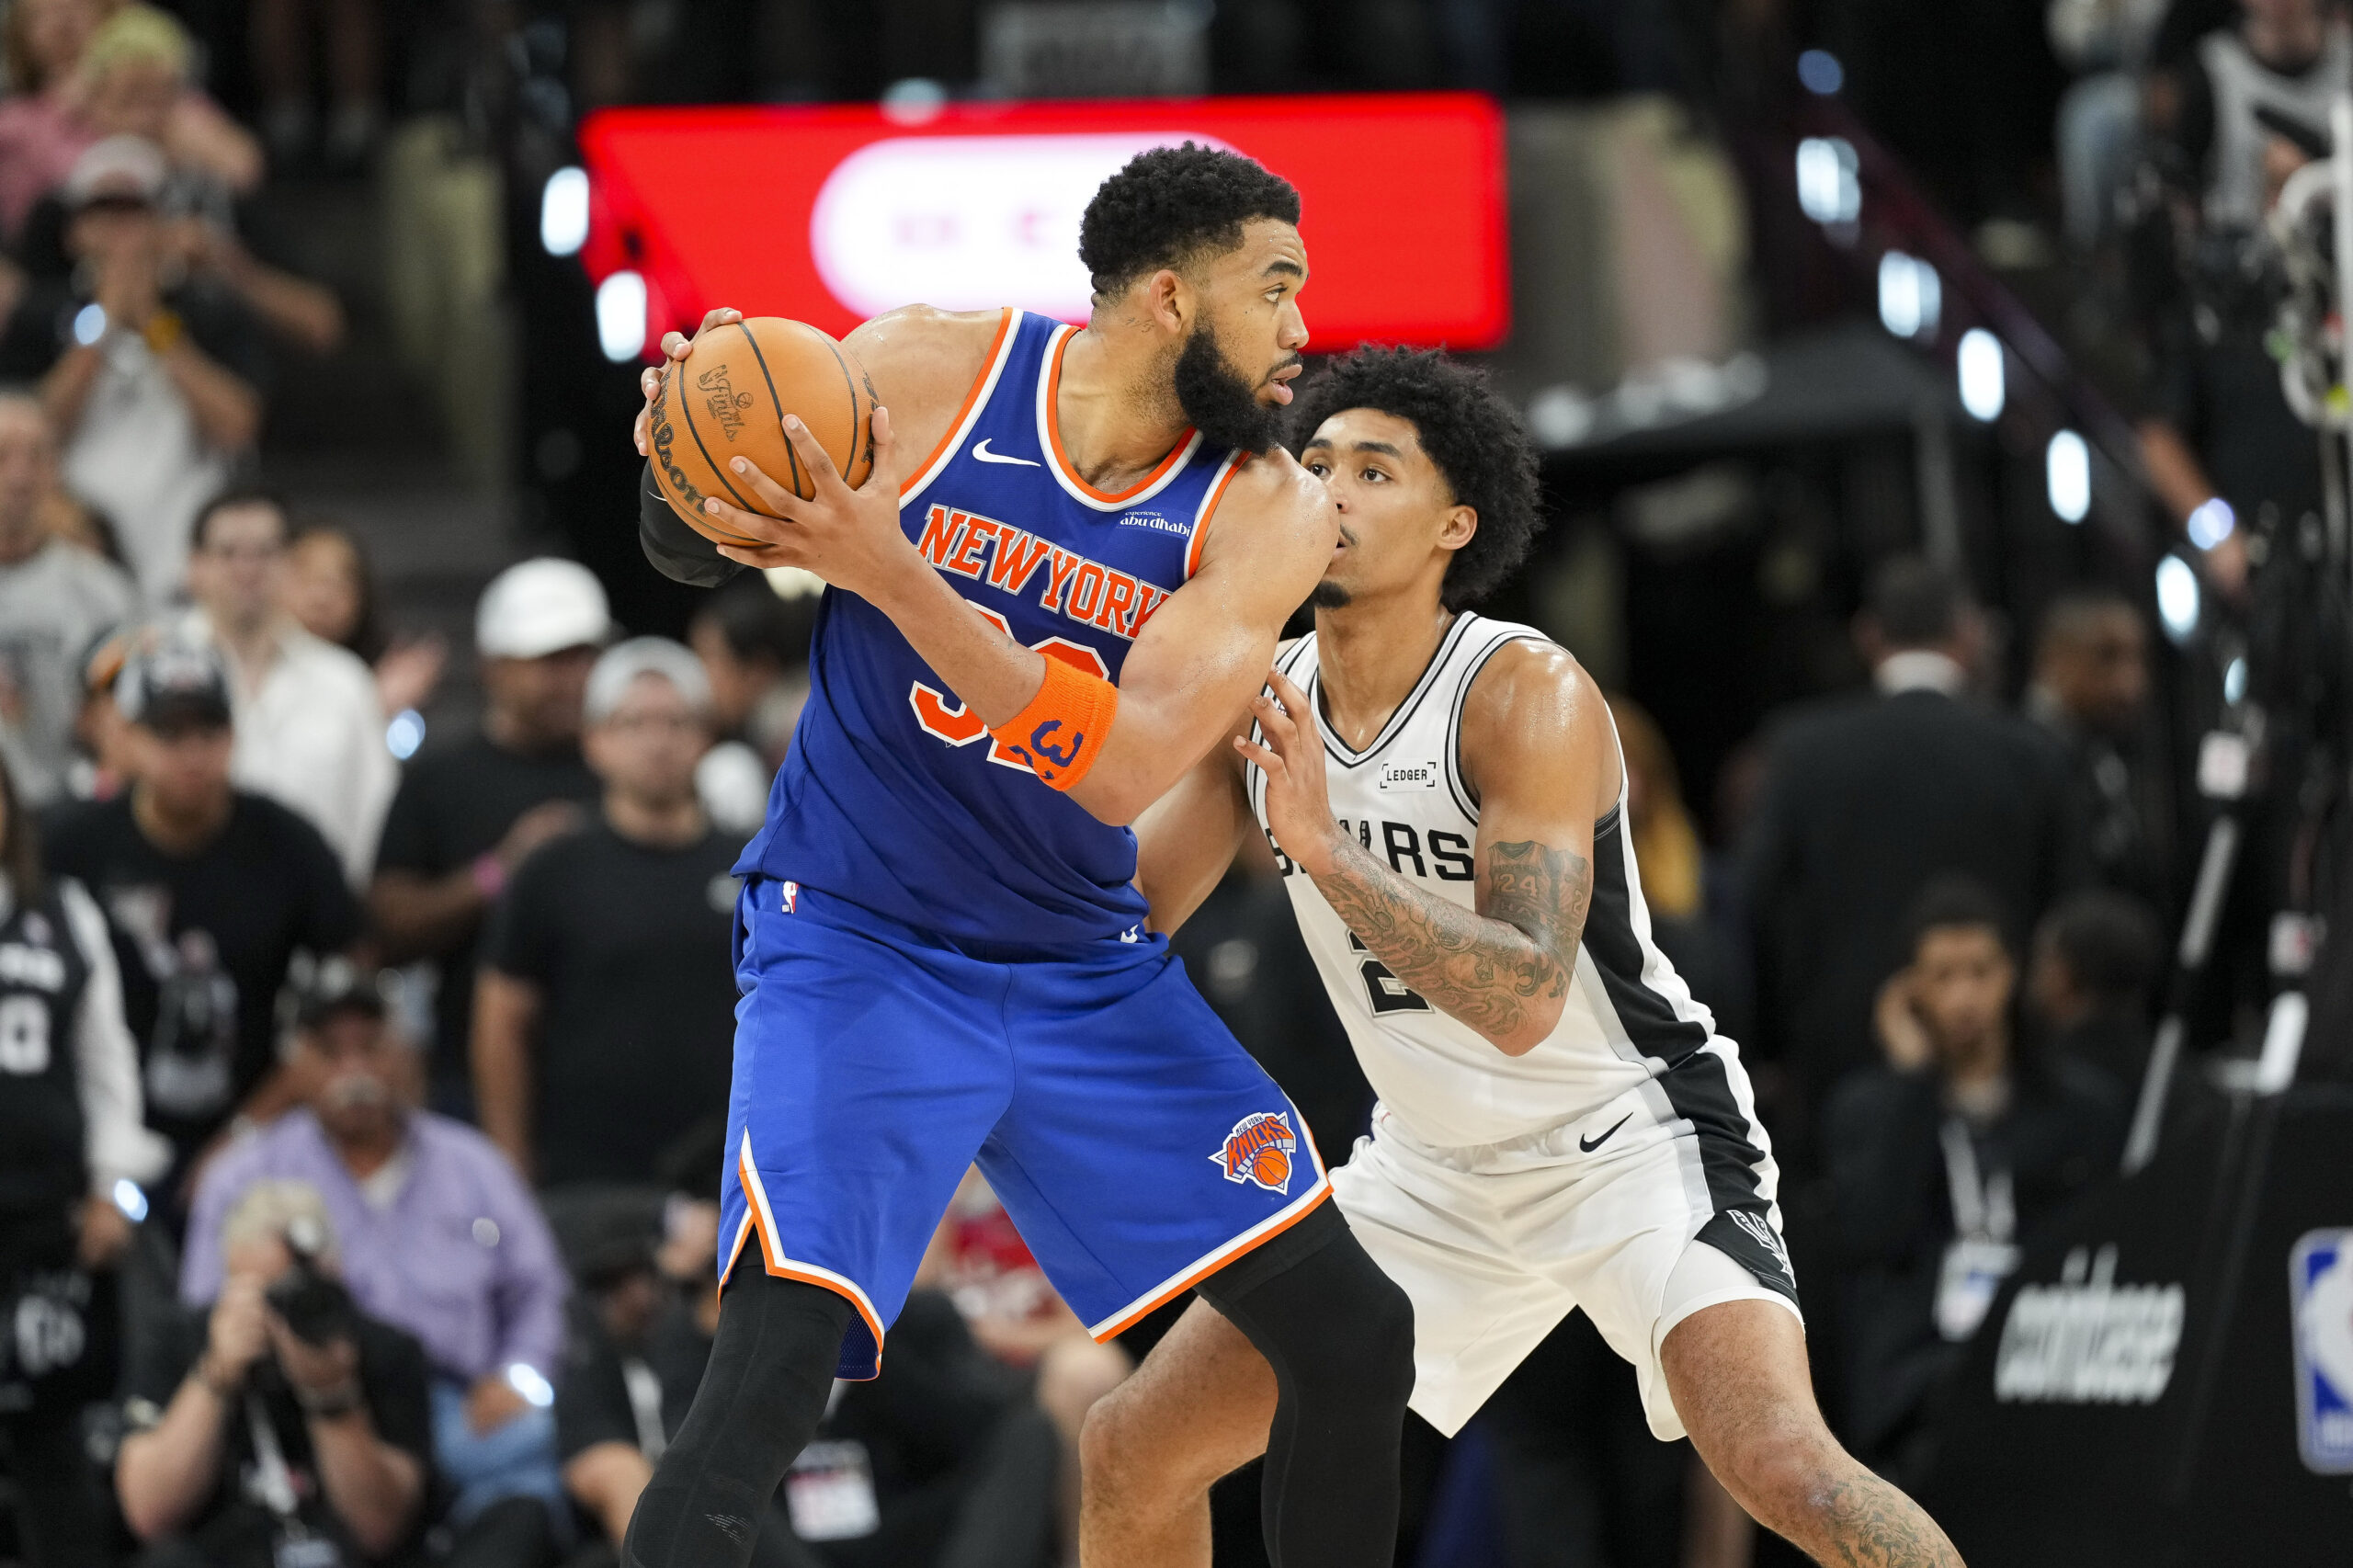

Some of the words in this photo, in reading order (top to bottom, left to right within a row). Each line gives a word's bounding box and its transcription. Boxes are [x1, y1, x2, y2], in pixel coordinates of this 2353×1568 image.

[1120, 516, 1147, 527] abu
[1149, 517, 1191, 538] dhabi
[918, 503, 1051, 596] NEW
[1386, 768, 1427, 781] LEDGER
[1499, 873, 1538, 898] 24
[1236, 1121, 1248, 1137] NEW
[1246, 1115, 1264, 1127] YORK
[1226, 1115, 1294, 1177] KNICKS
